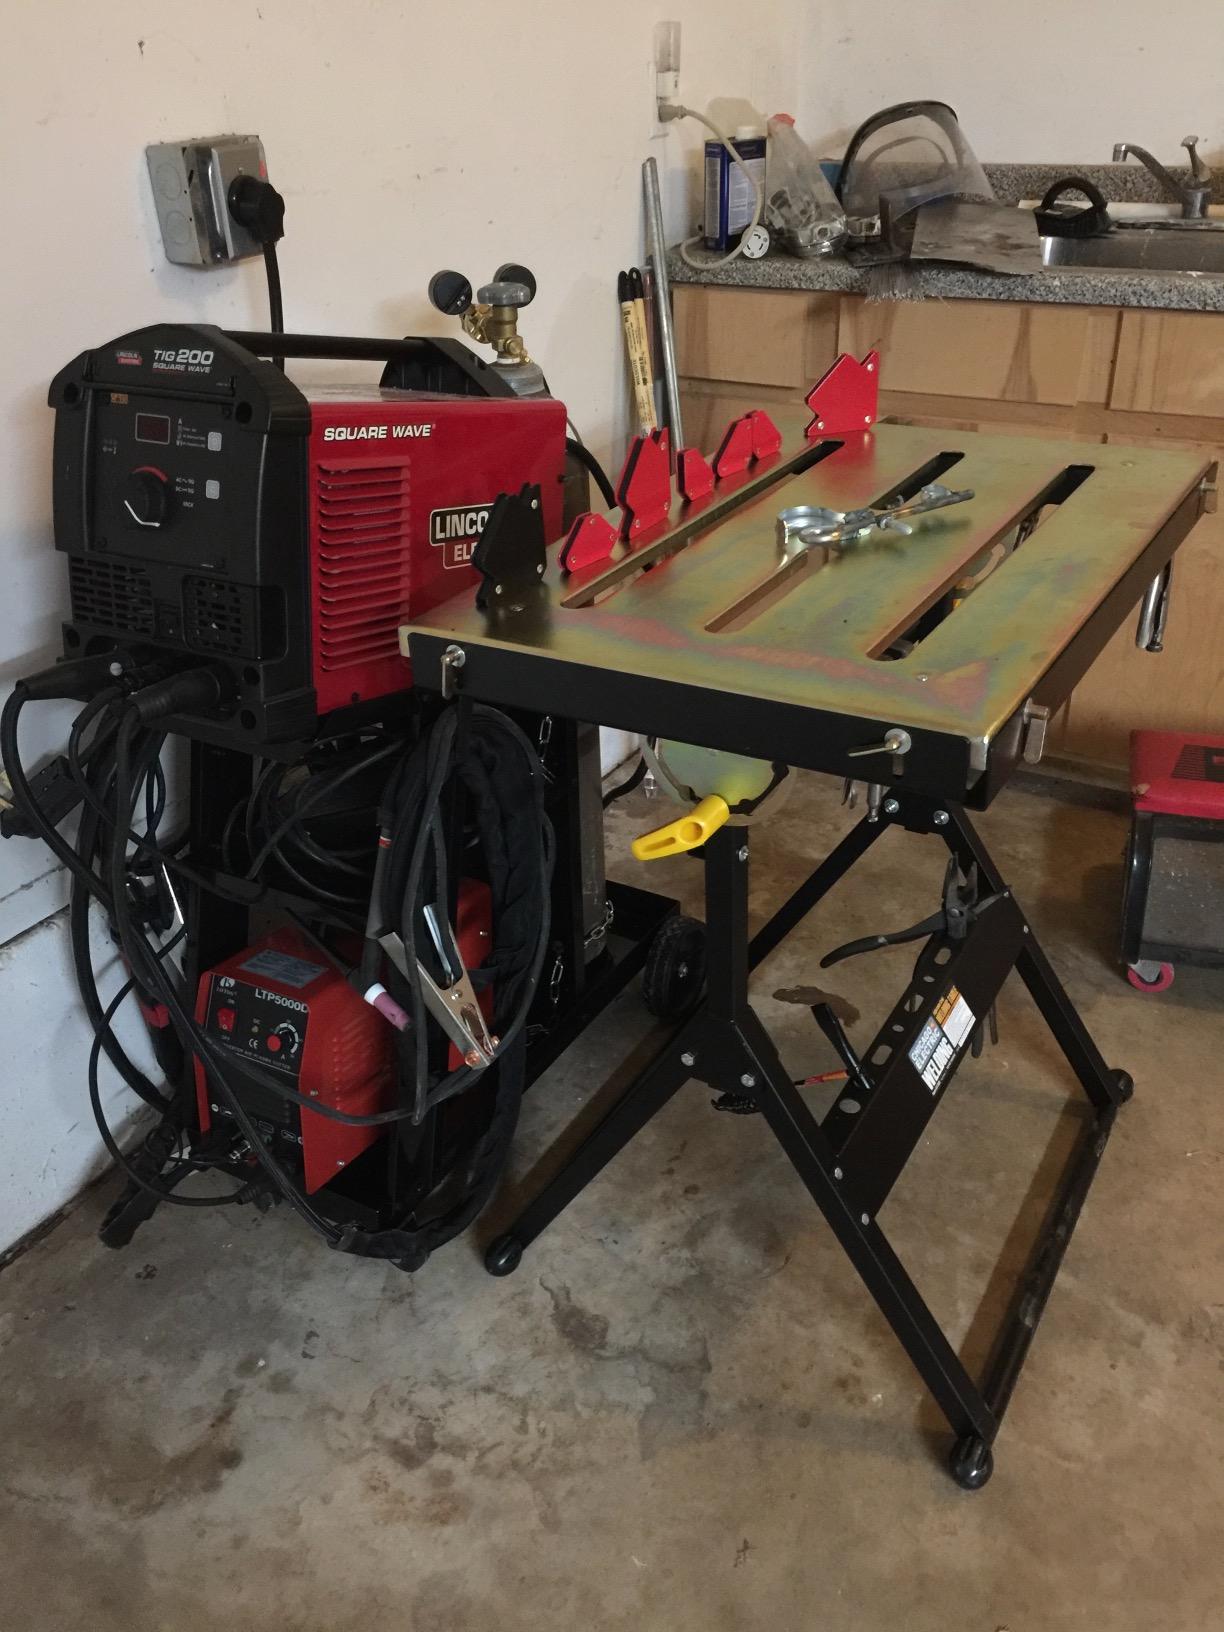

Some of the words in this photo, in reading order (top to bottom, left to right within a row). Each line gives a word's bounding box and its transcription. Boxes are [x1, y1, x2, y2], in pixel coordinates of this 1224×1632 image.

[152, 362, 186, 372] SQUARE
[188, 365, 211, 374] WAVE
[323, 426, 388, 441] SQUARE
[392, 424, 432, 438] WAVE
[254, 988, 309, 1013] LTP5000D
